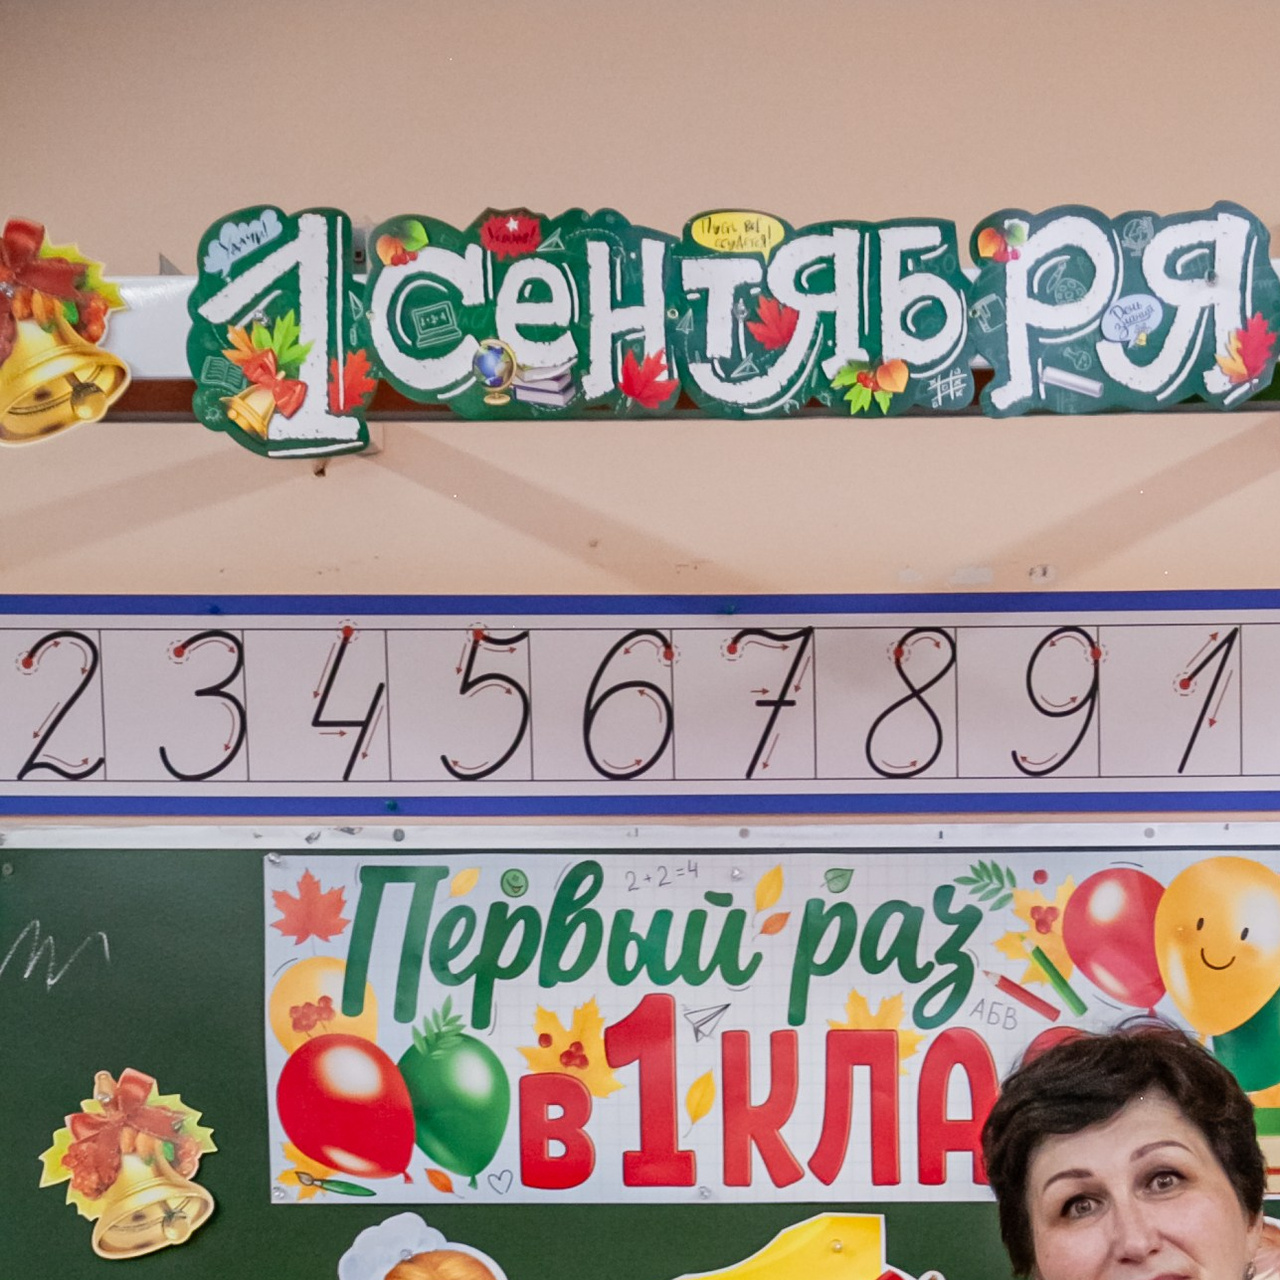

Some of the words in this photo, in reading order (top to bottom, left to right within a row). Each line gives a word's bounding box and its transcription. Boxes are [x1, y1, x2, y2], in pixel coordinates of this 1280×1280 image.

[198, 213, 360, 442] 1
[17, 631, 105, 781] 2
[160, 630, 247, 781] 3
[311, 627, 386, 782] 4
[441, 629, 530, 779] 5
[583, 629, 674, 779] 6
[731, 626, 815, 779] 7
[865, 626, 957, 778] 8
[1011, 625, 1101, 776] 9
[341, 859, 763, 1030] Первый
[787, 884, 984, 1030] раз
[603, 993, 696, 1189] 1
